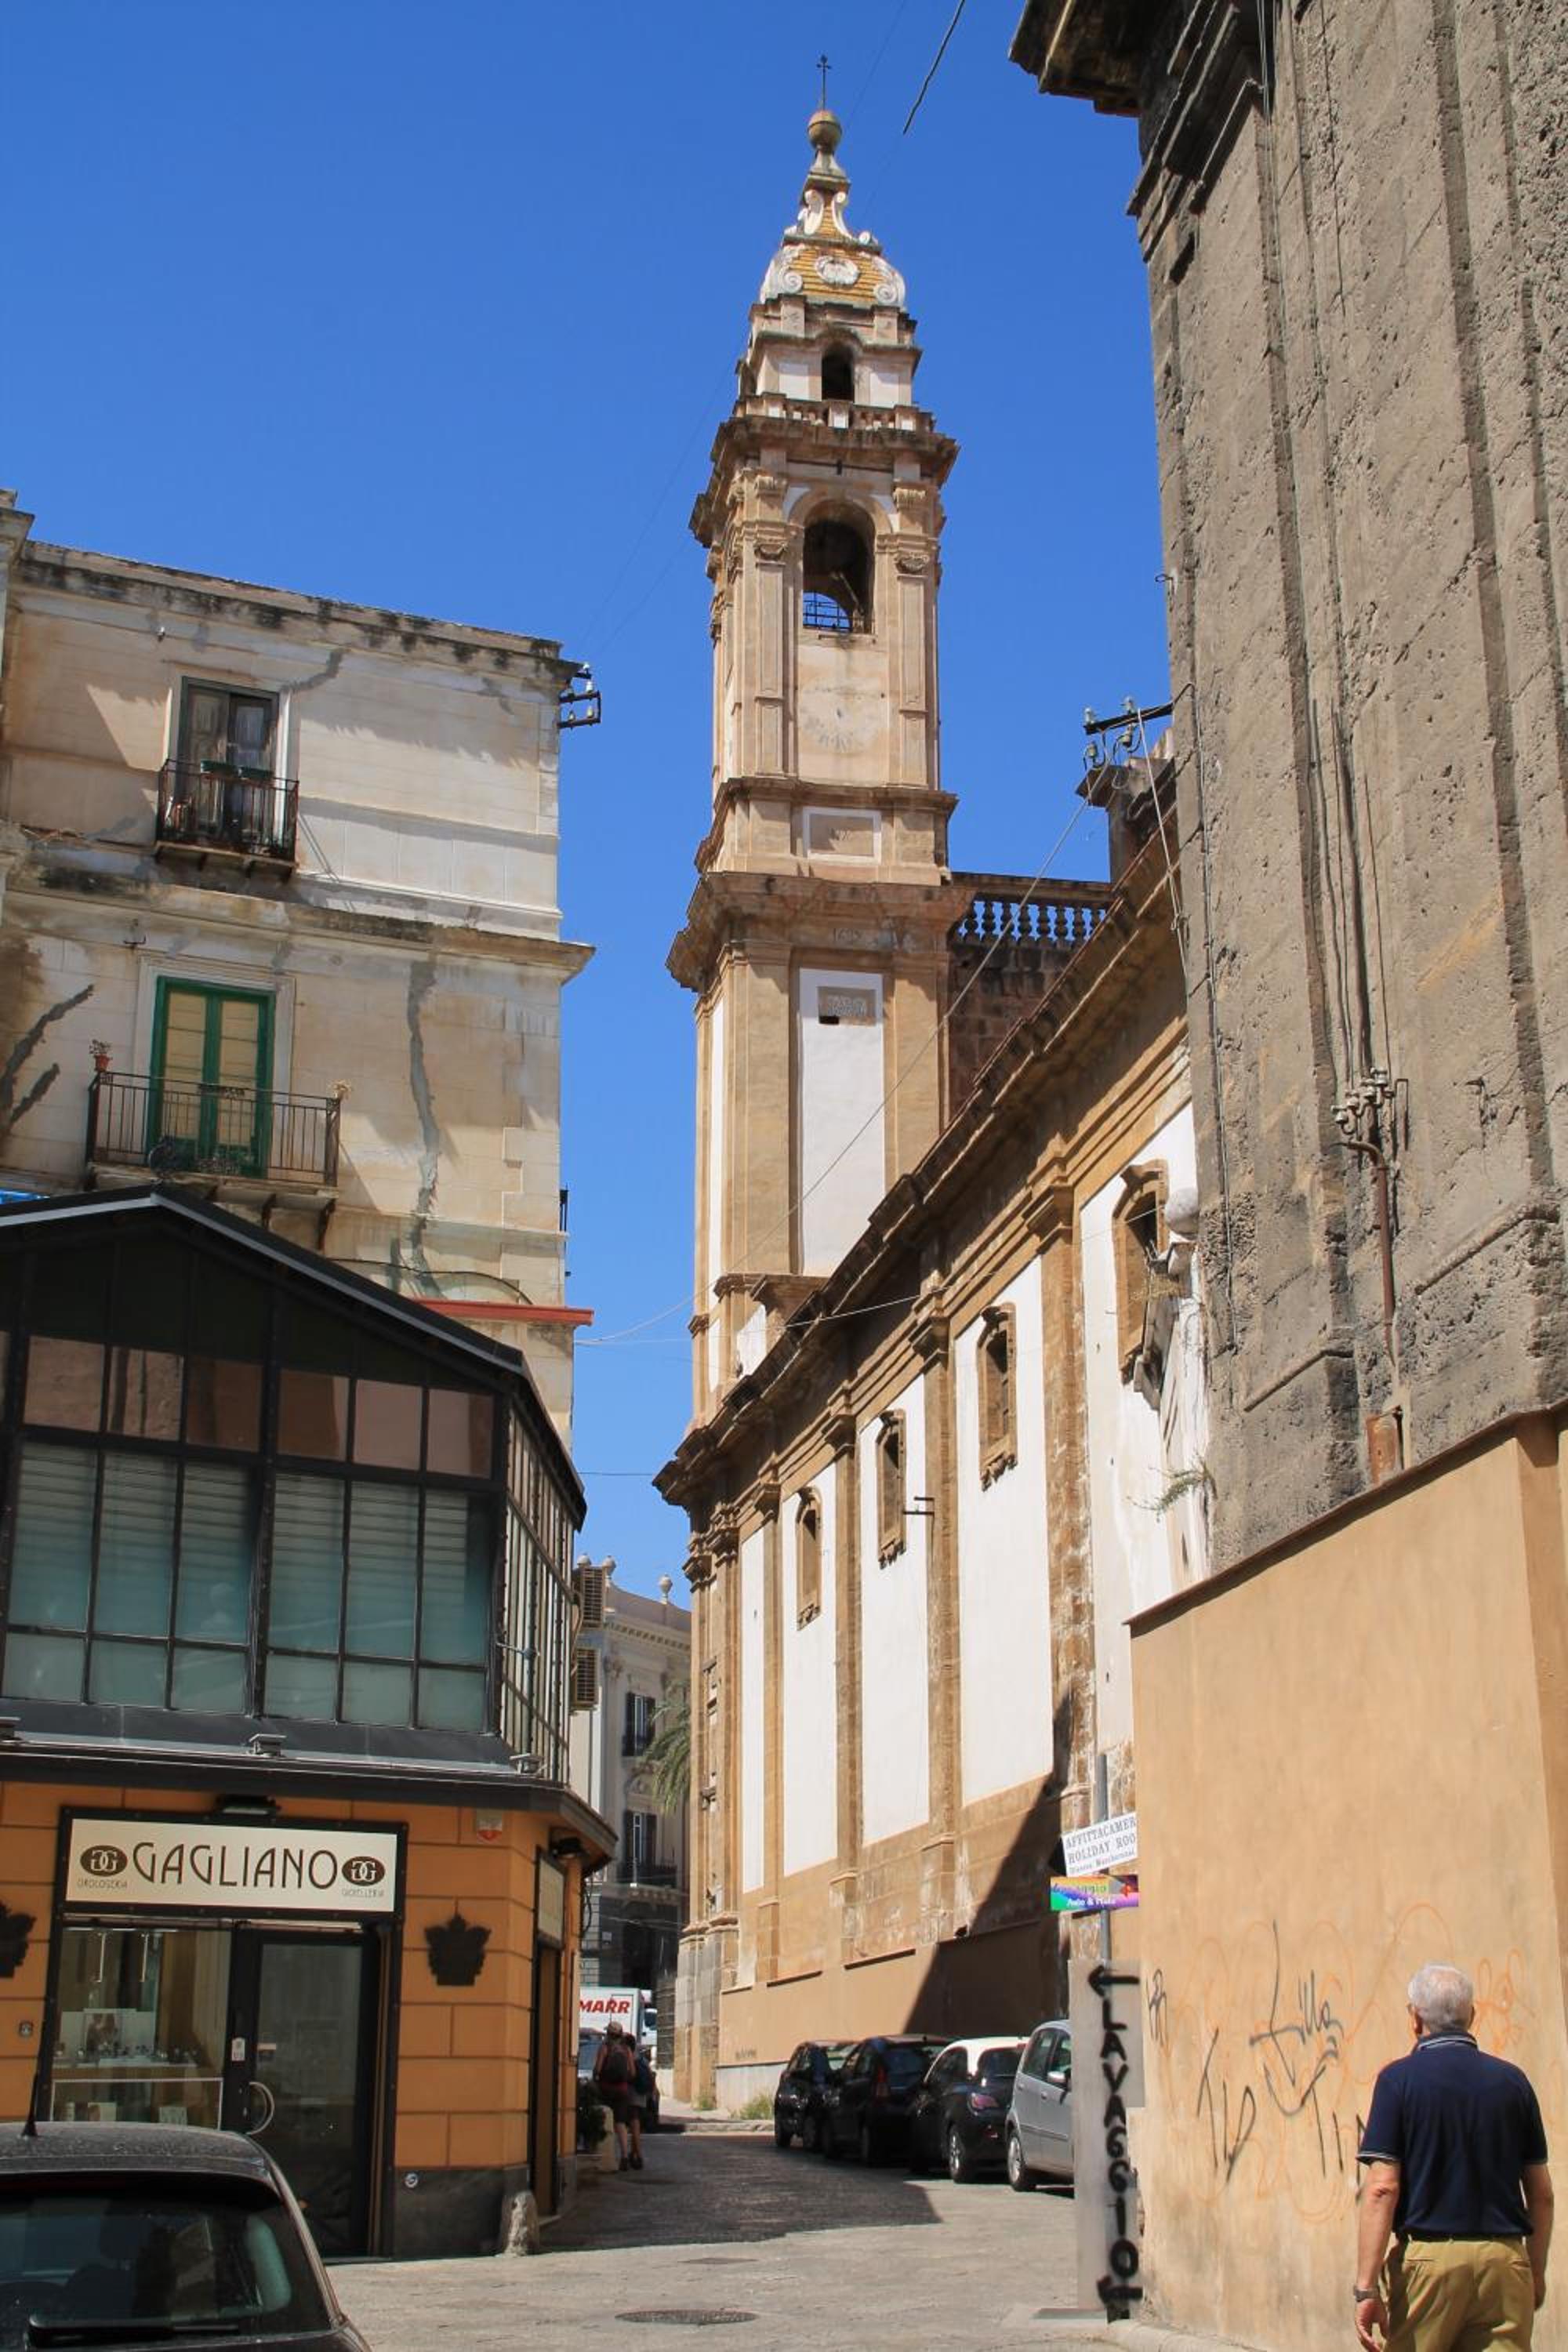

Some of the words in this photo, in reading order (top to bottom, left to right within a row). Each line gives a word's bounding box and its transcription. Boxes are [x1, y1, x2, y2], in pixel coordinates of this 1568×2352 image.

[132, 1842, 338, 1890] GAGLIANO
[1067, 1840, 1110, 1864] HOLIDAY
[579, 1999, 630, 2014] MARR
[1100, 1998, 1139, 2278] LAVAGGIO
